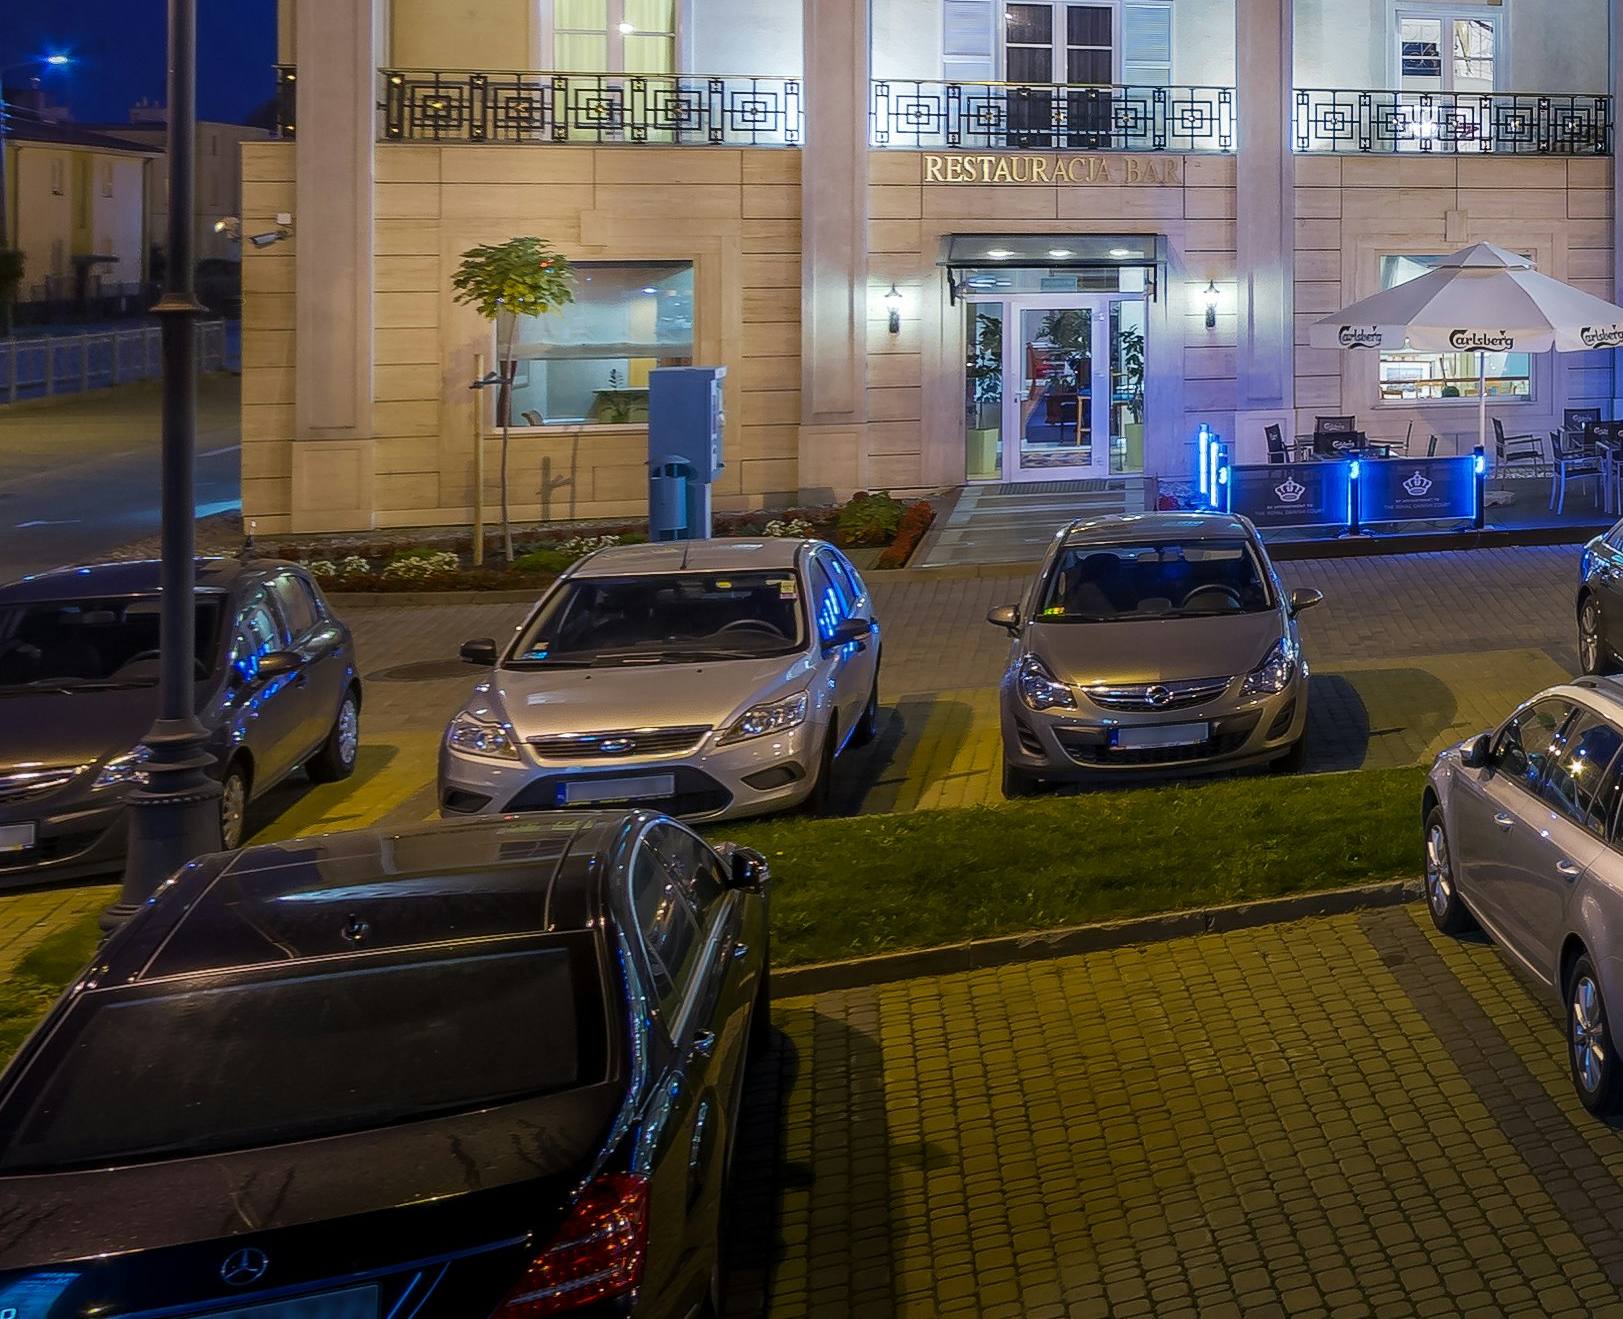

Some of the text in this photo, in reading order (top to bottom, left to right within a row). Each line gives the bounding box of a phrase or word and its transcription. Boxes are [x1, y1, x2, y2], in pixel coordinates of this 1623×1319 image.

[924, 155, 1183, 184] RESTAURACJA BAR
[1338, 325, 1382, 350] Carlsberg
[1449, 329, 1514, 352] Carlsberg
